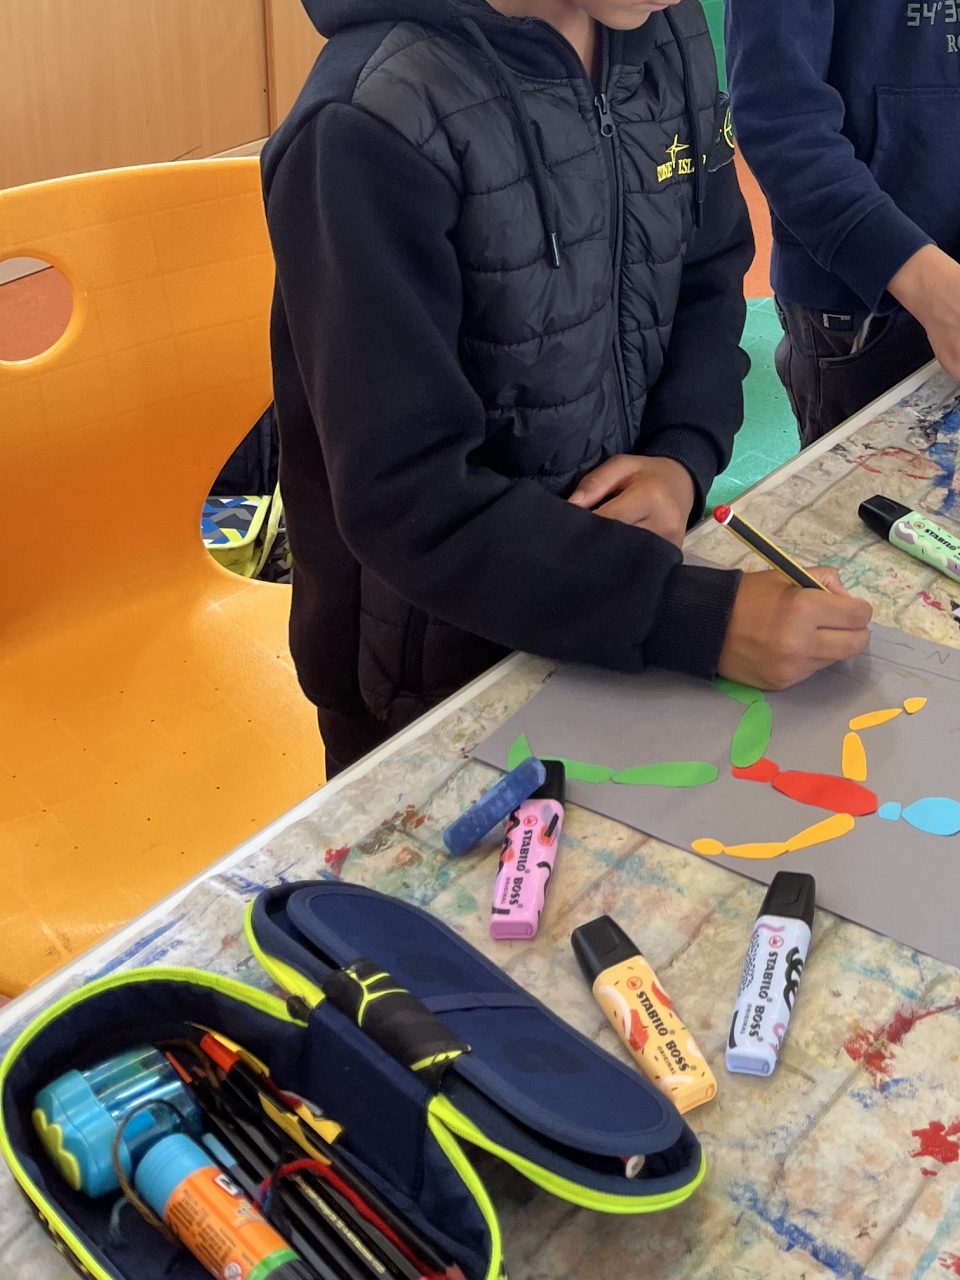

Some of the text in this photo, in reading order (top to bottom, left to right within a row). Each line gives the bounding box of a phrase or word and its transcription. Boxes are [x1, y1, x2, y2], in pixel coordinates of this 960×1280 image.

[923, 526, 957, 551] STABILO
[509, 828, 533, 907] STABILO BOSS
[635, 988, 691, 1071] STABILO BOSS
[748, 949, 778, 1042] STABILO BOSS
[656, 1045, 677, 1076] ORIGINAL
